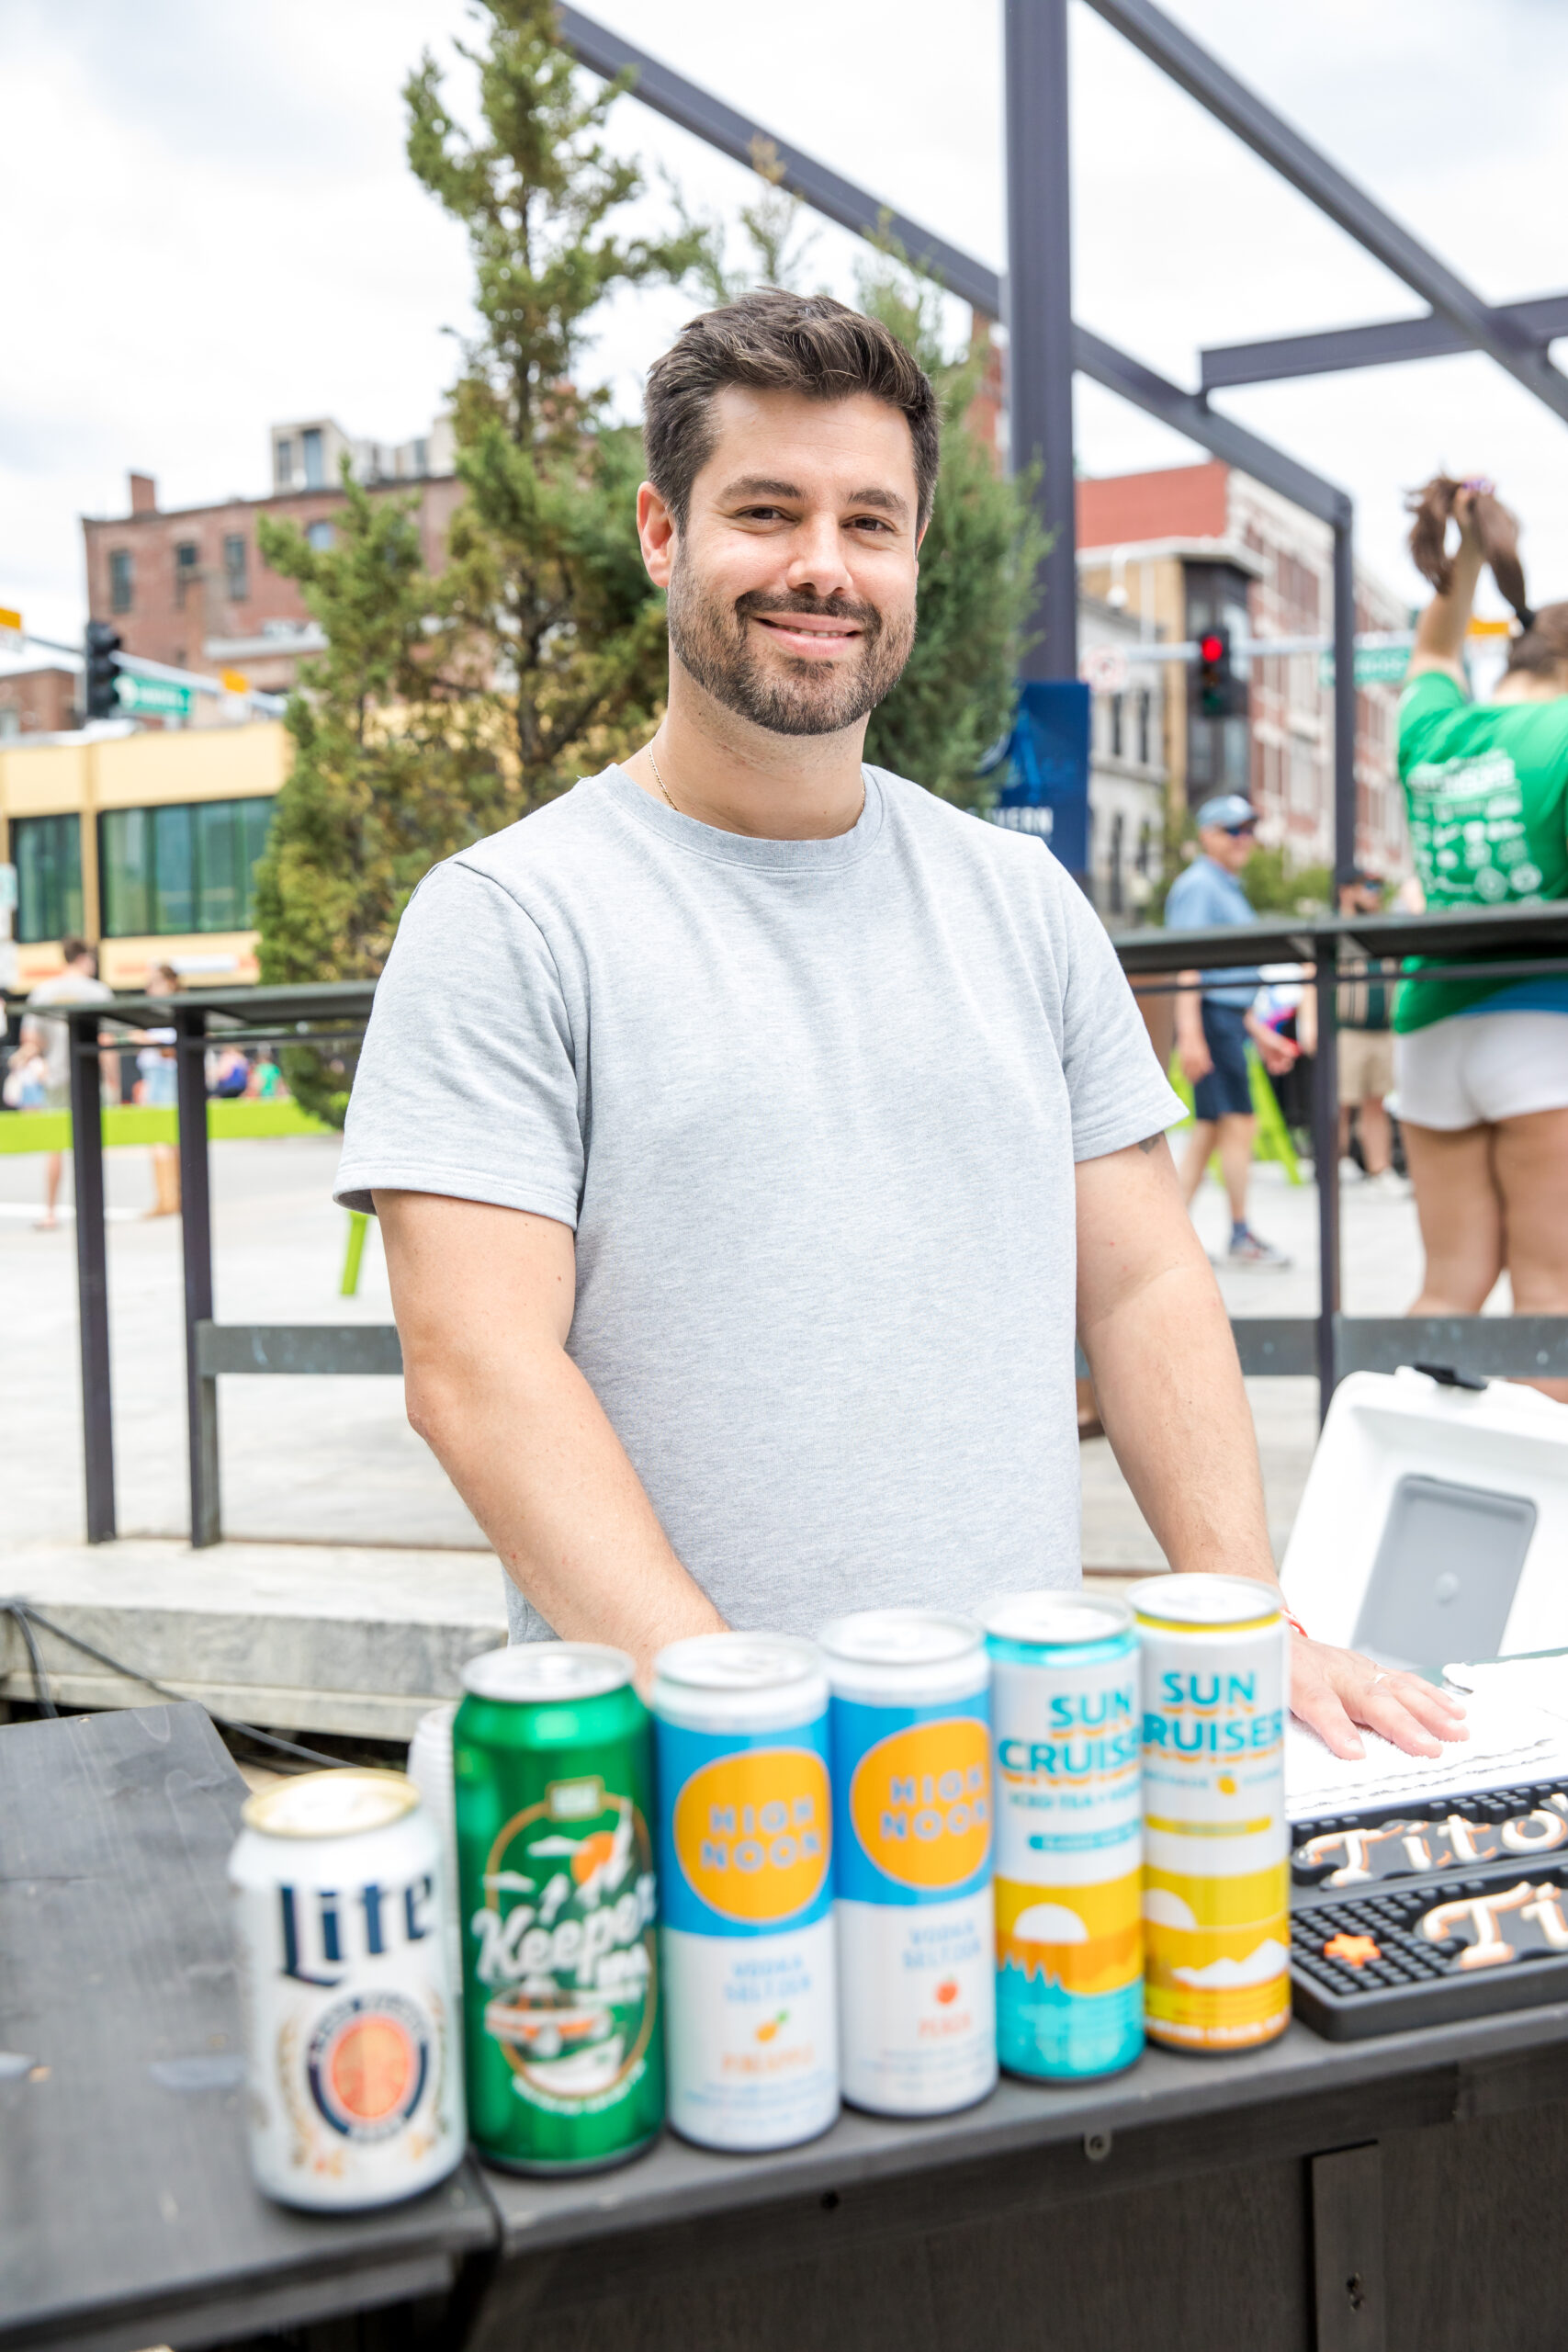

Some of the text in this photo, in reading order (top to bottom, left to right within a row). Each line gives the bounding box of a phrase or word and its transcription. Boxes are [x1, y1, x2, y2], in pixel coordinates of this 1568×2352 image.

[1049, 1684, 1133, 1729] SUN
[1161, 1672, 1255, 1706] SUN
[1143, 1709, 1283, 1753] RUISER
[889, 1761, 984, 1806] HIGH
[708, 1792, 816, 1837] HIGH
[879, 1797, 988, 1842] NOON
[699, 1825, 822, 1873] NOON
[1298, 1792, 1568, 1888] Tito'
[278, 1874, 433, 1988] Lite
[1423, 1881, 1568, 1969] Ti
